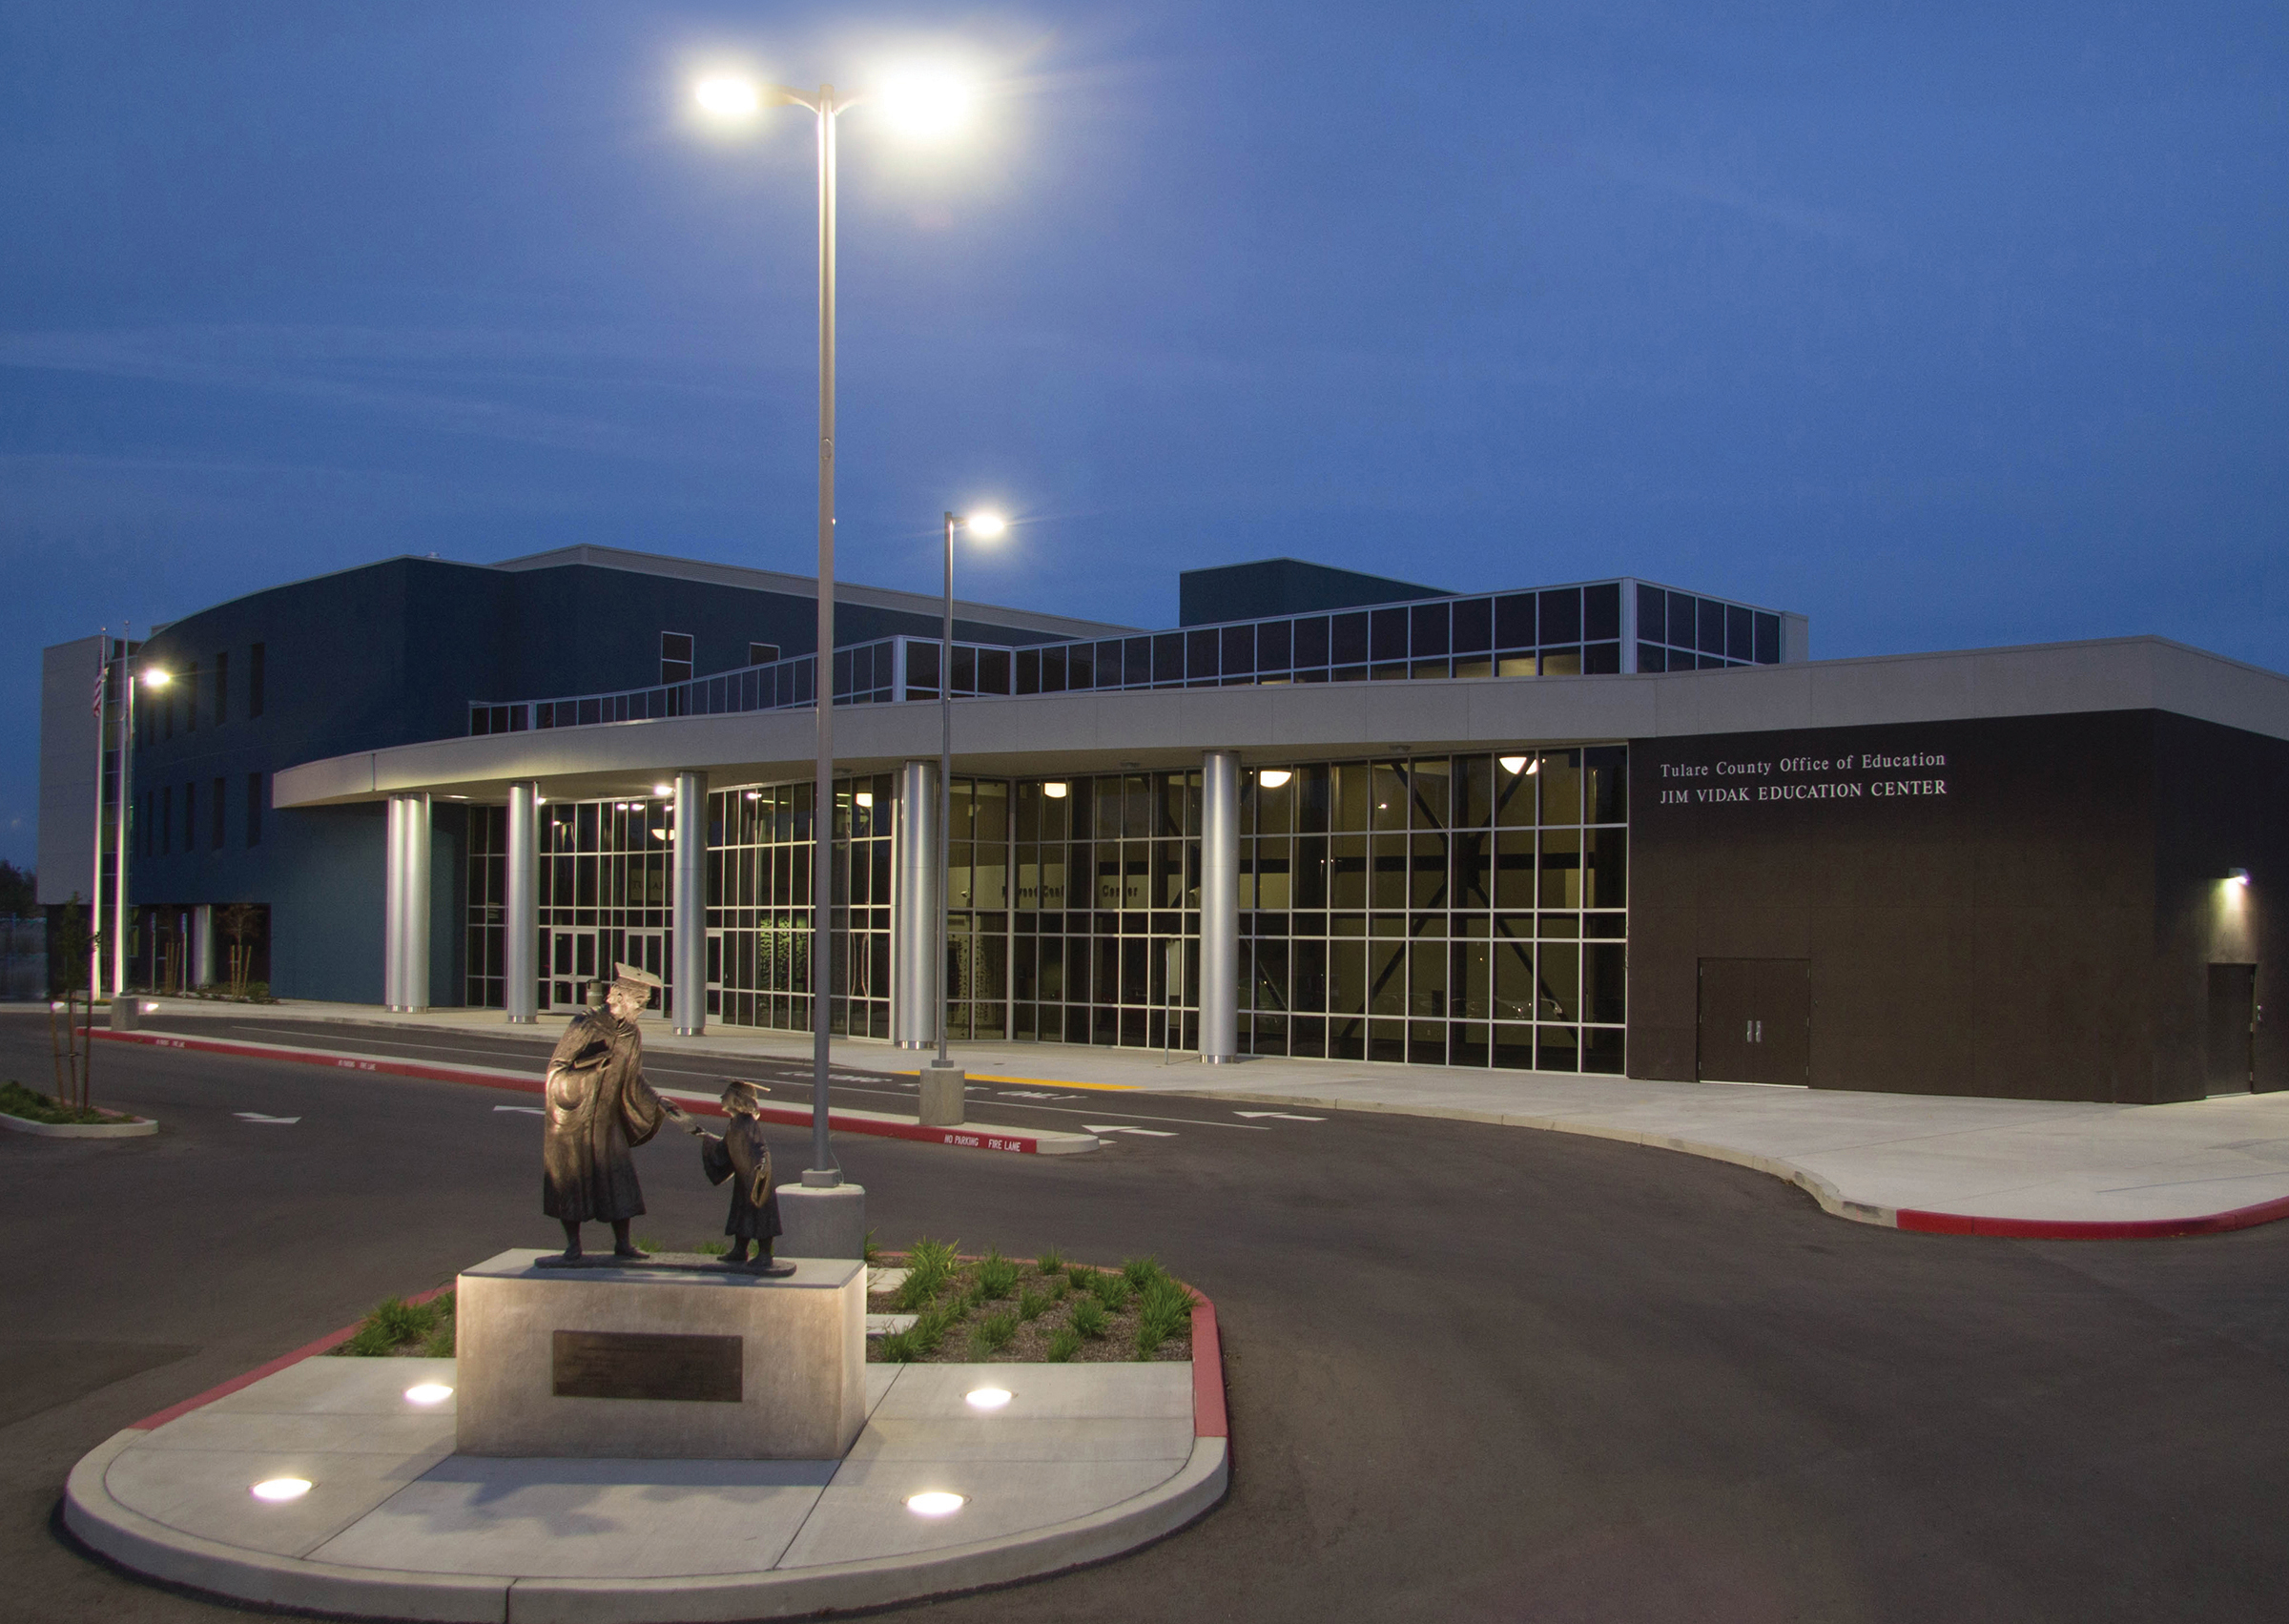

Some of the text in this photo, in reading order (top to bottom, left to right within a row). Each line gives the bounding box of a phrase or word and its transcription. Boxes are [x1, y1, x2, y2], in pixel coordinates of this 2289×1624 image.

[1660, 751, 1946, 777] Tulare County Office of Education
[1660, 779, 1948, 804] JIM VIDAK EDUCATION CENTER
[1103, 885, 1138, 897] Cener
[944, 1134, 1021, 1152] NO PARKING FIRE LANE
